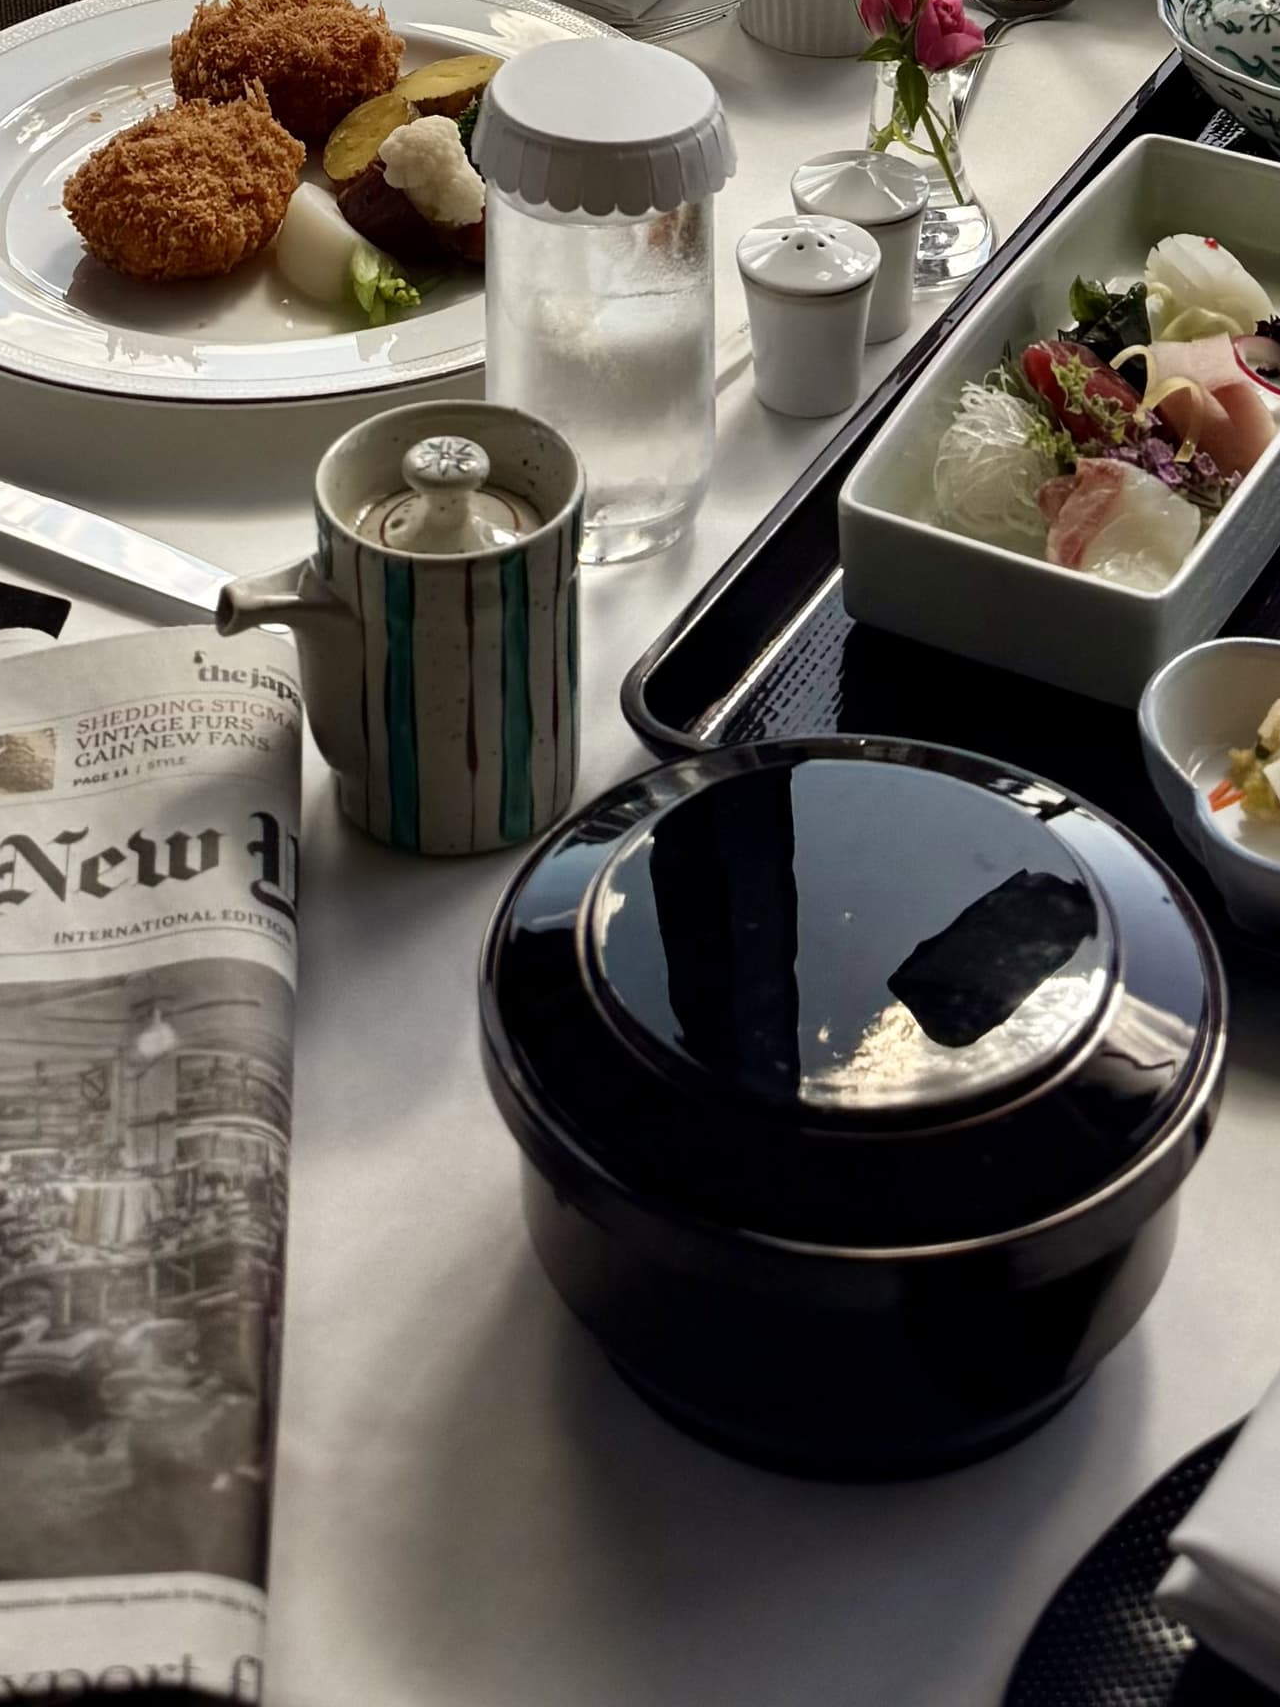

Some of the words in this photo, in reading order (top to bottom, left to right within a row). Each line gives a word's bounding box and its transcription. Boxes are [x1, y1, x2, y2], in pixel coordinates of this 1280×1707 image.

[198, 665, 247, 683] the
[76, 699, 204, 734] SHEDDING
[76, 717, 183, 751] VINTAGE
[191, 715, 255, 732] FURS
[74, 742, 134, 768] GAIN
[143, 732, 197, 753] NEW
[209, 731, 271, 752] FANS
[73, 772, 108, 787] PAGE
[147, 756, 186, 770] STYLE
[54, 911, 216, 945] INTERNATIONAL
